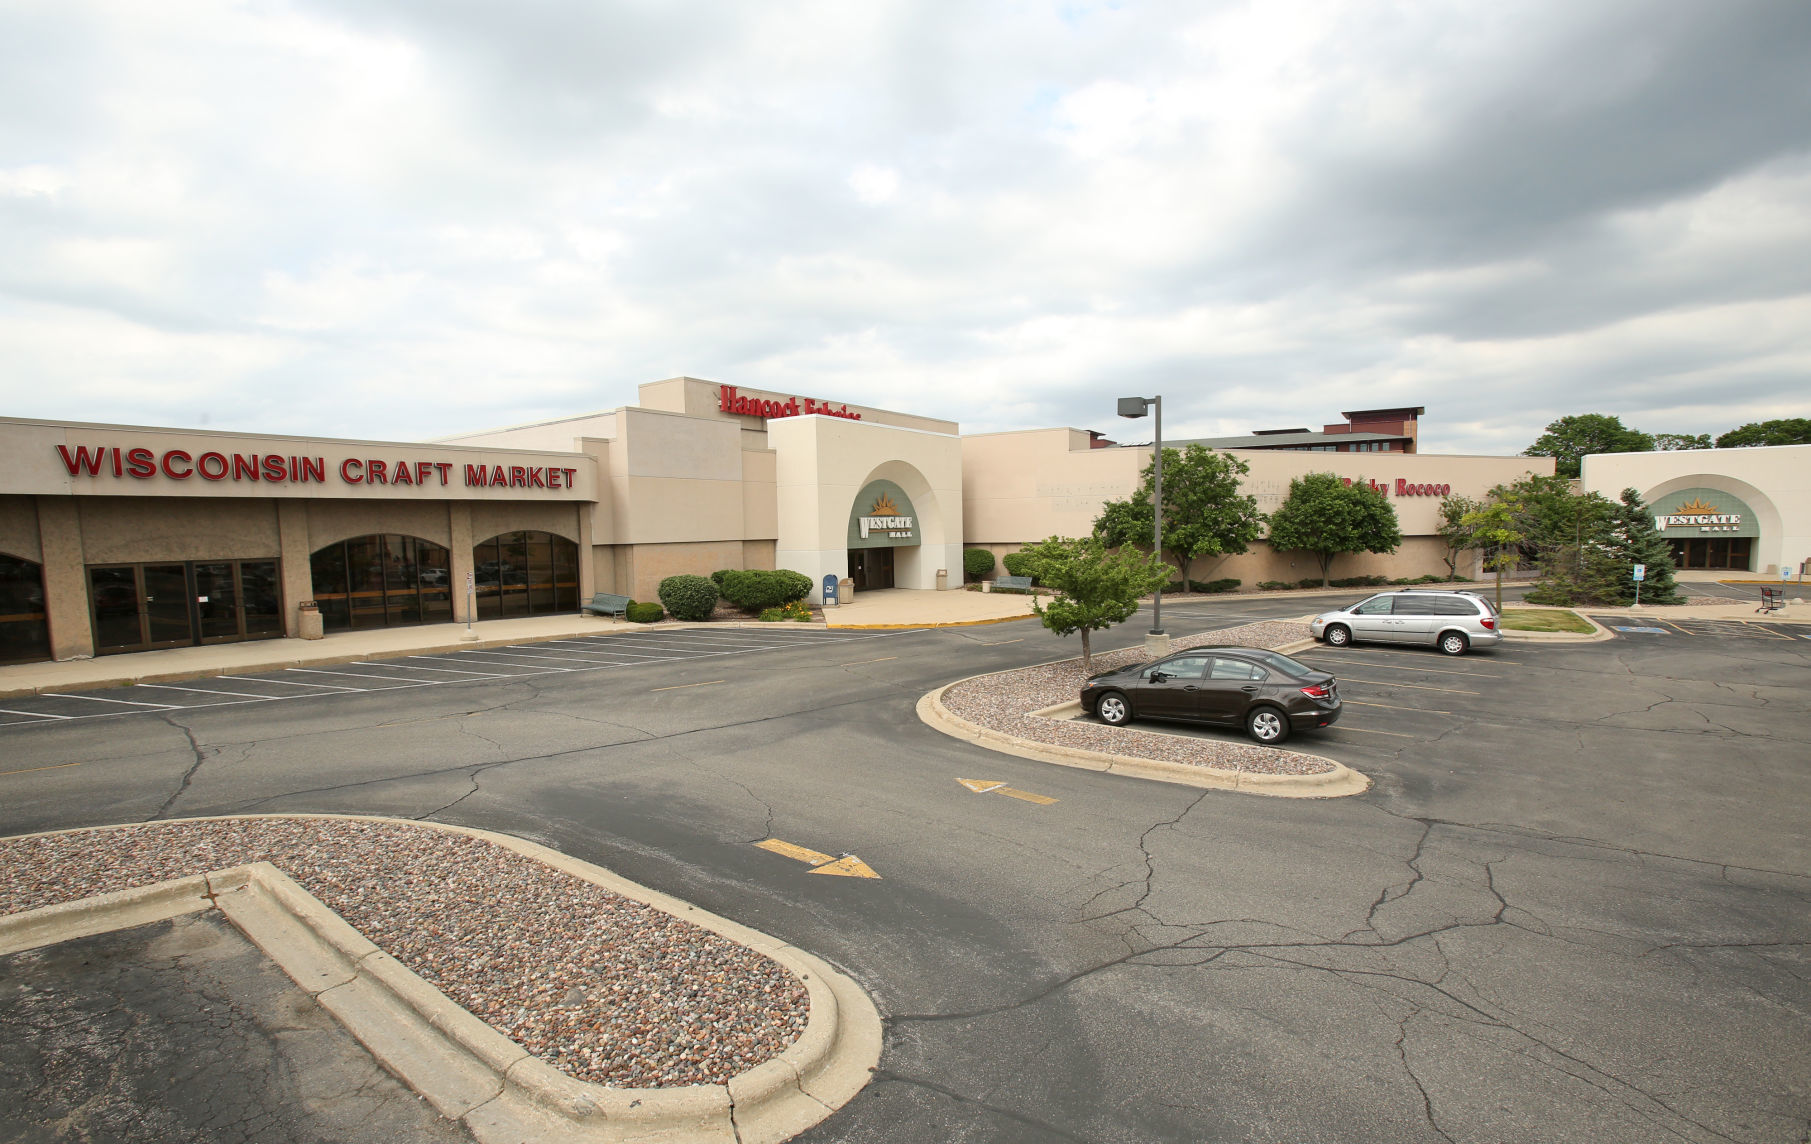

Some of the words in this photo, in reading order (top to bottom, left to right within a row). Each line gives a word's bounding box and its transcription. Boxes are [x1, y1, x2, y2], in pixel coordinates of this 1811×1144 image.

[720, 385, 801, 418] Hancock
[56, 444, 326, 483] WISCONSIN
[340, 458, 453, 486] CRAFT
[464, 464, 577, 489] MARKET
[1341, 477, 1389, 499] Rky
[1395, 478, 1451, 496] Rococo
[858, 516, 913, 539] WESTGATE
[1655, 514, 1740, 532] WESTGATE
